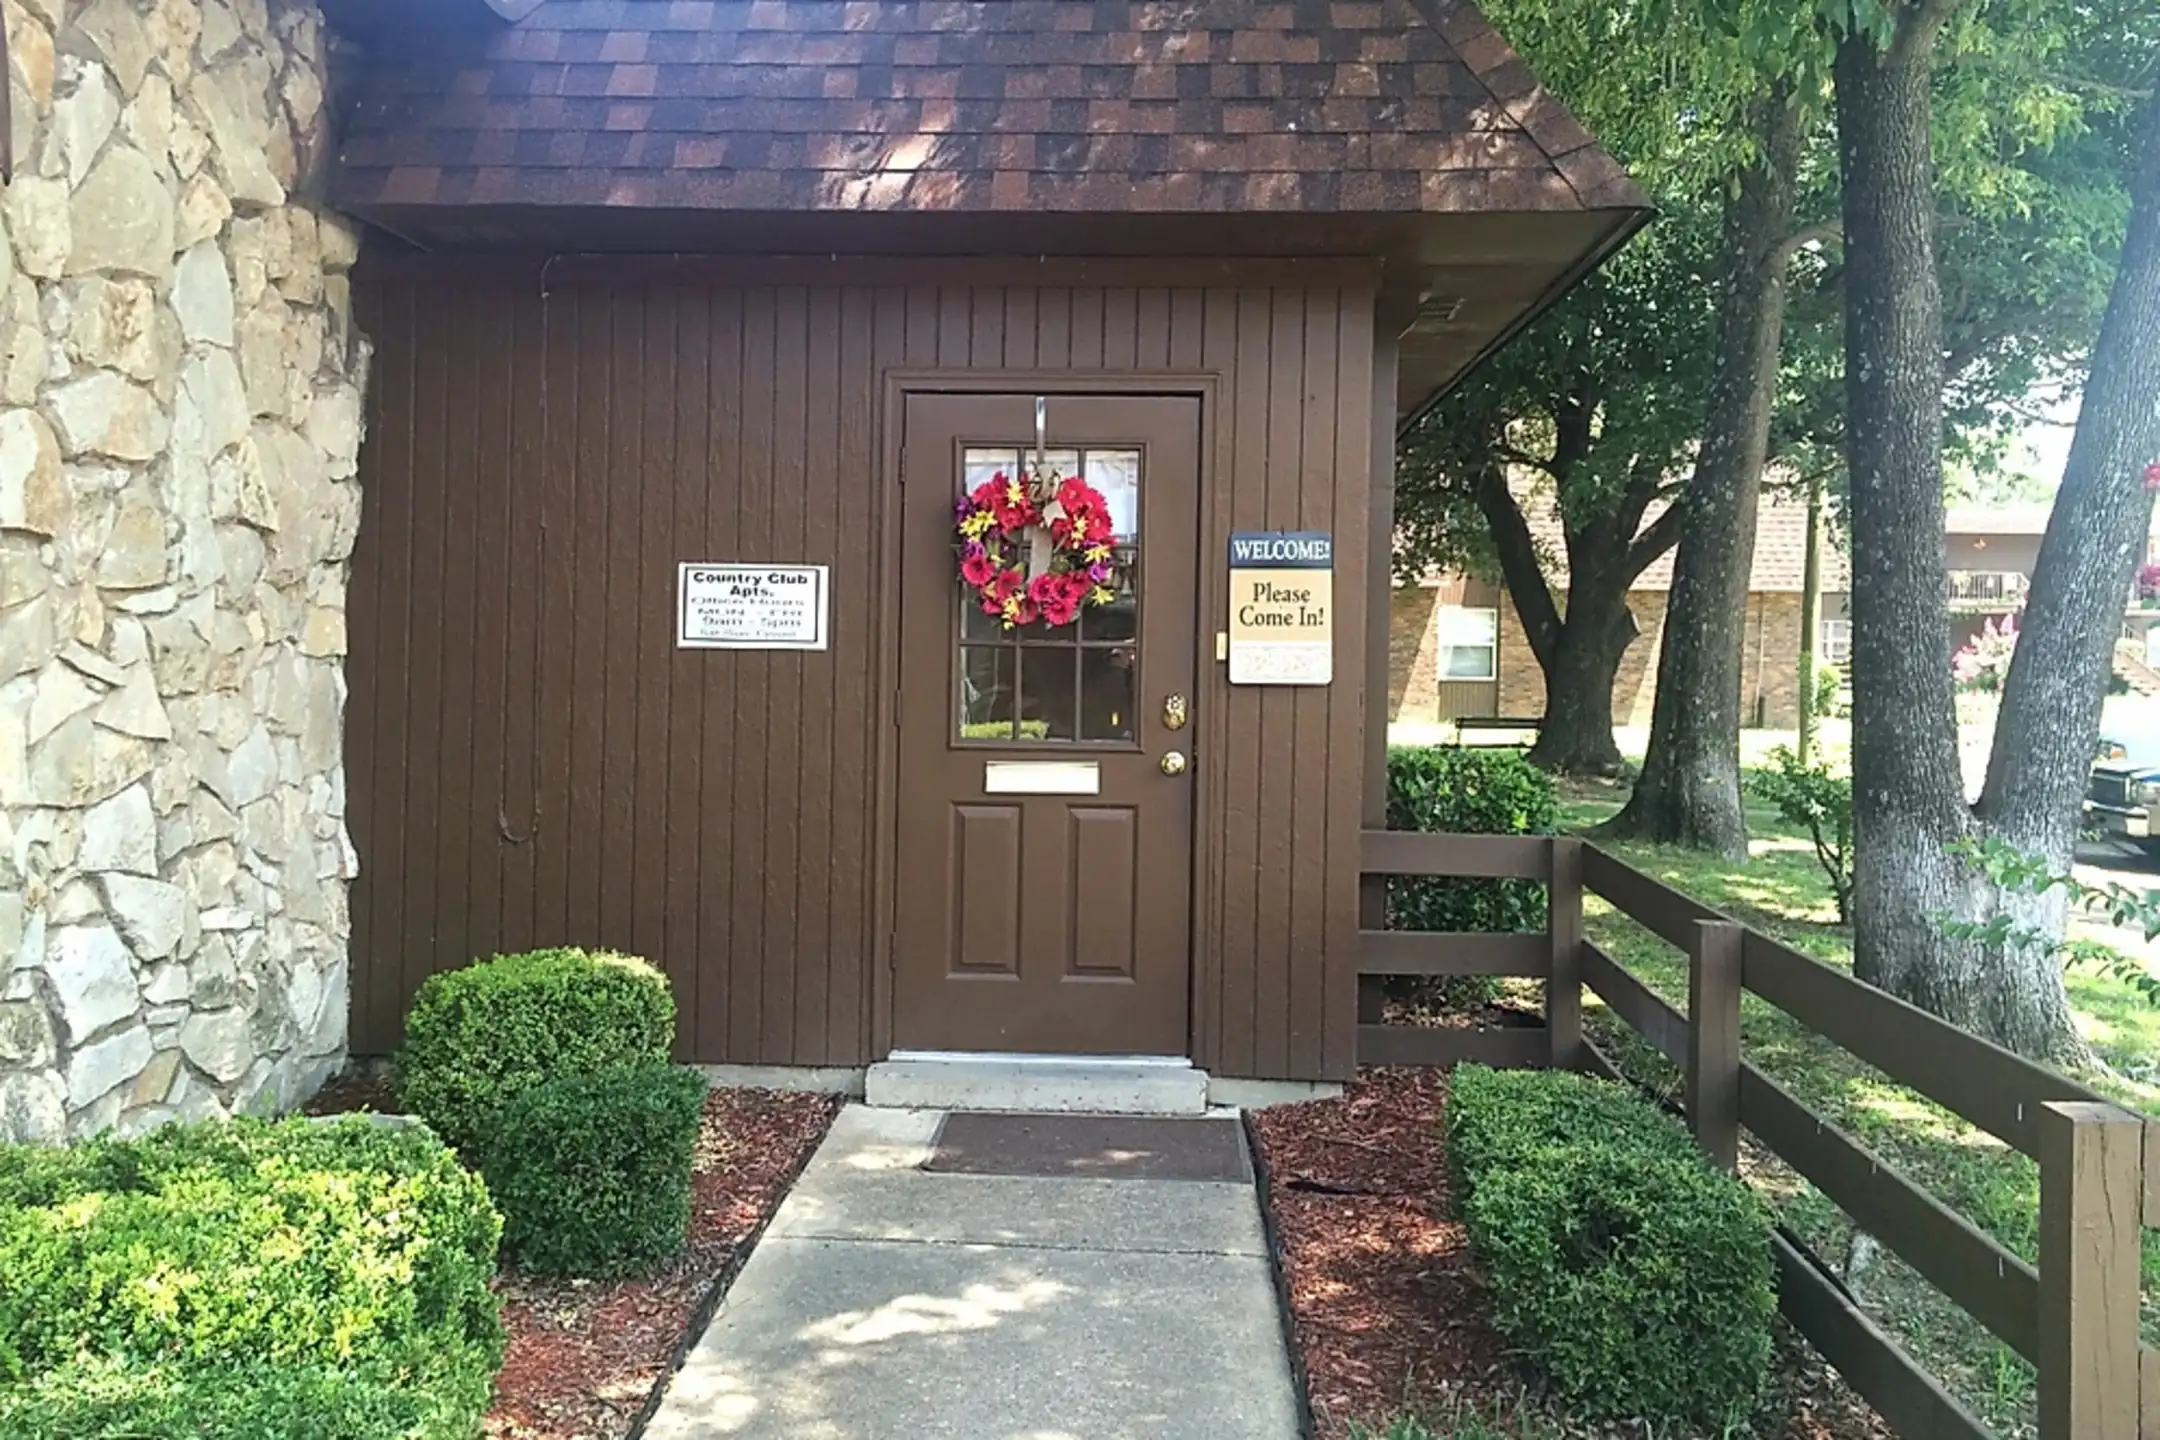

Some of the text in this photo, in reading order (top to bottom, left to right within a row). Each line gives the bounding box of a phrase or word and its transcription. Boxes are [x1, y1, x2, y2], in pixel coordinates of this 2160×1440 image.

[1234, 539, 1330, 560] WELCOME!
[693, 572, 808, 586] Country Club
[730, 585, 775, 598] Apts.
[1252, 581, 1311, 603] Please
[1239, 605, 1324, 626] Come In!
